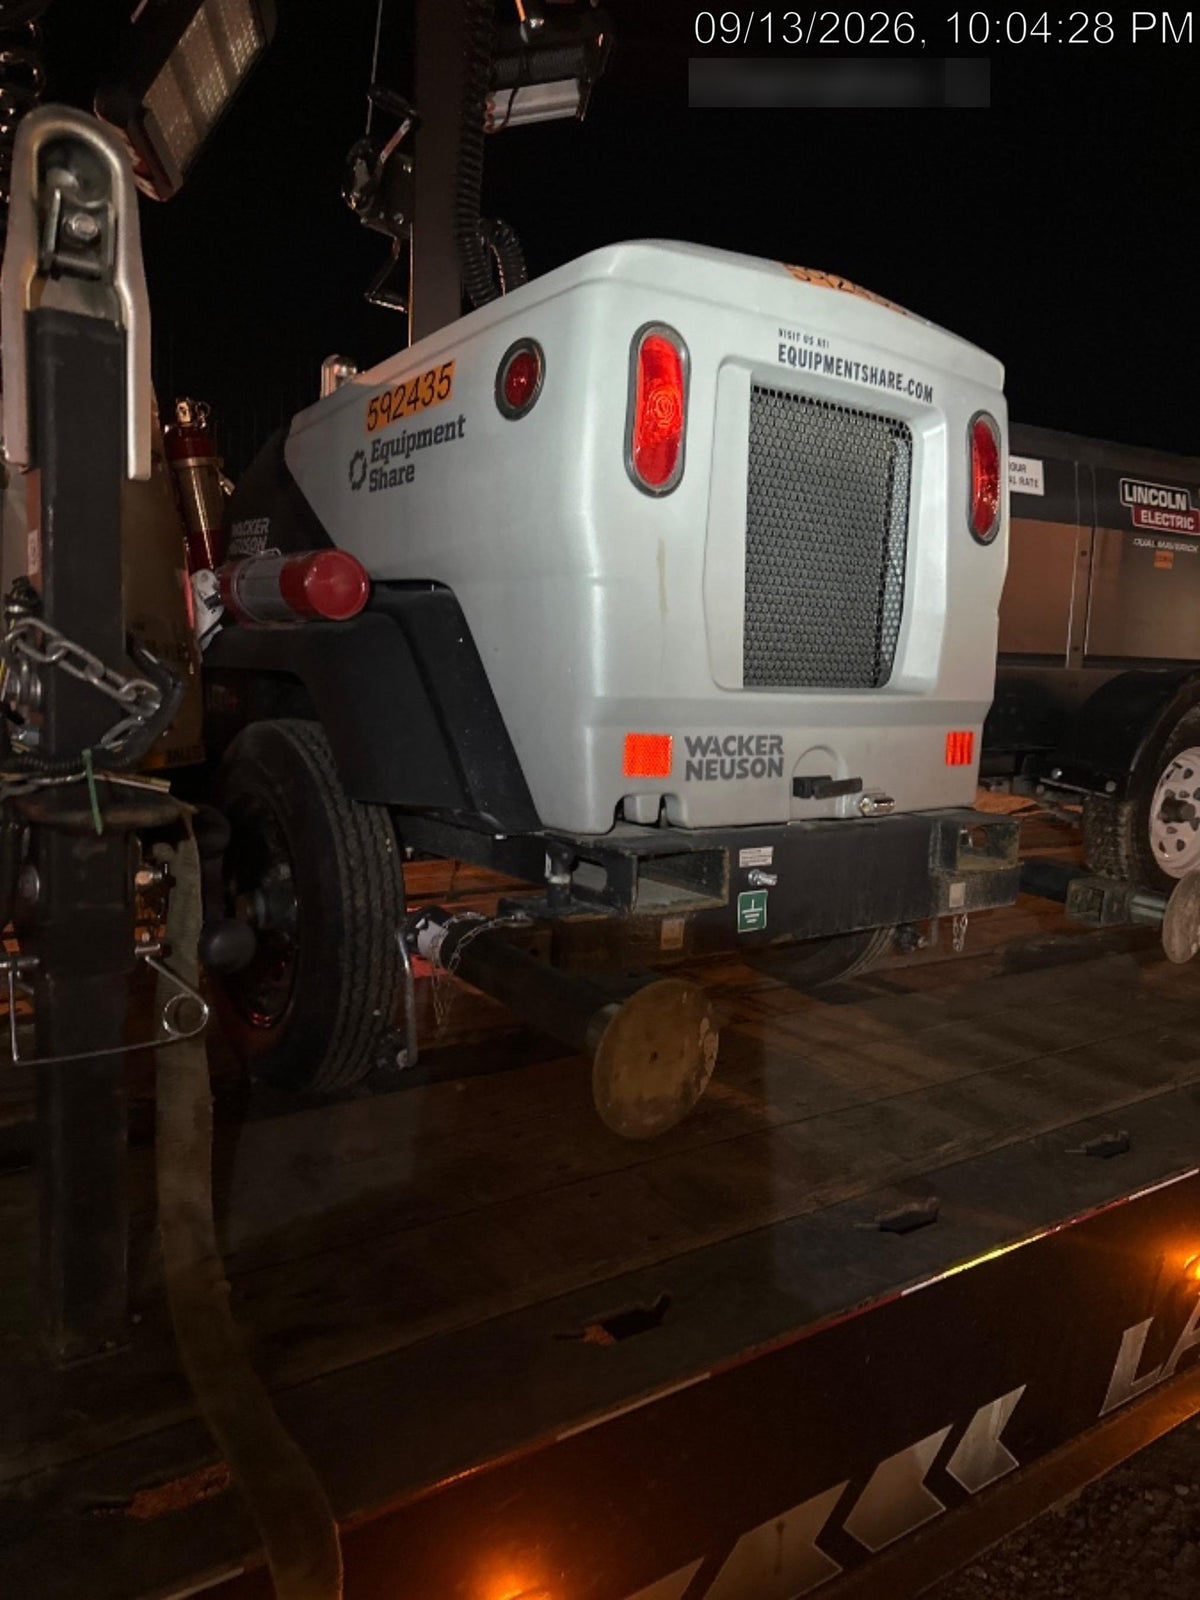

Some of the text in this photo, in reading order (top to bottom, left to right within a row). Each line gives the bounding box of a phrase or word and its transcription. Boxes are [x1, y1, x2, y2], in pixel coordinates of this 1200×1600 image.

[778, 328, 801, 339] VISIT
[803, 333, 814, 346] US
[778, 343, 934, 403] EQUIPMENTSHARE.COM
[366, 362, 453, 432] 592435
[370, 413, 466, 465] Equipment
[368, 463, 415, 493] Share
[1124, 483, 1188, 511] LINCOLN
[1140, 509, 1195, 531] ELECTRIC
[684, 735, 784, 758] WACKER
[685, 757, 784, 782] NEUSON
